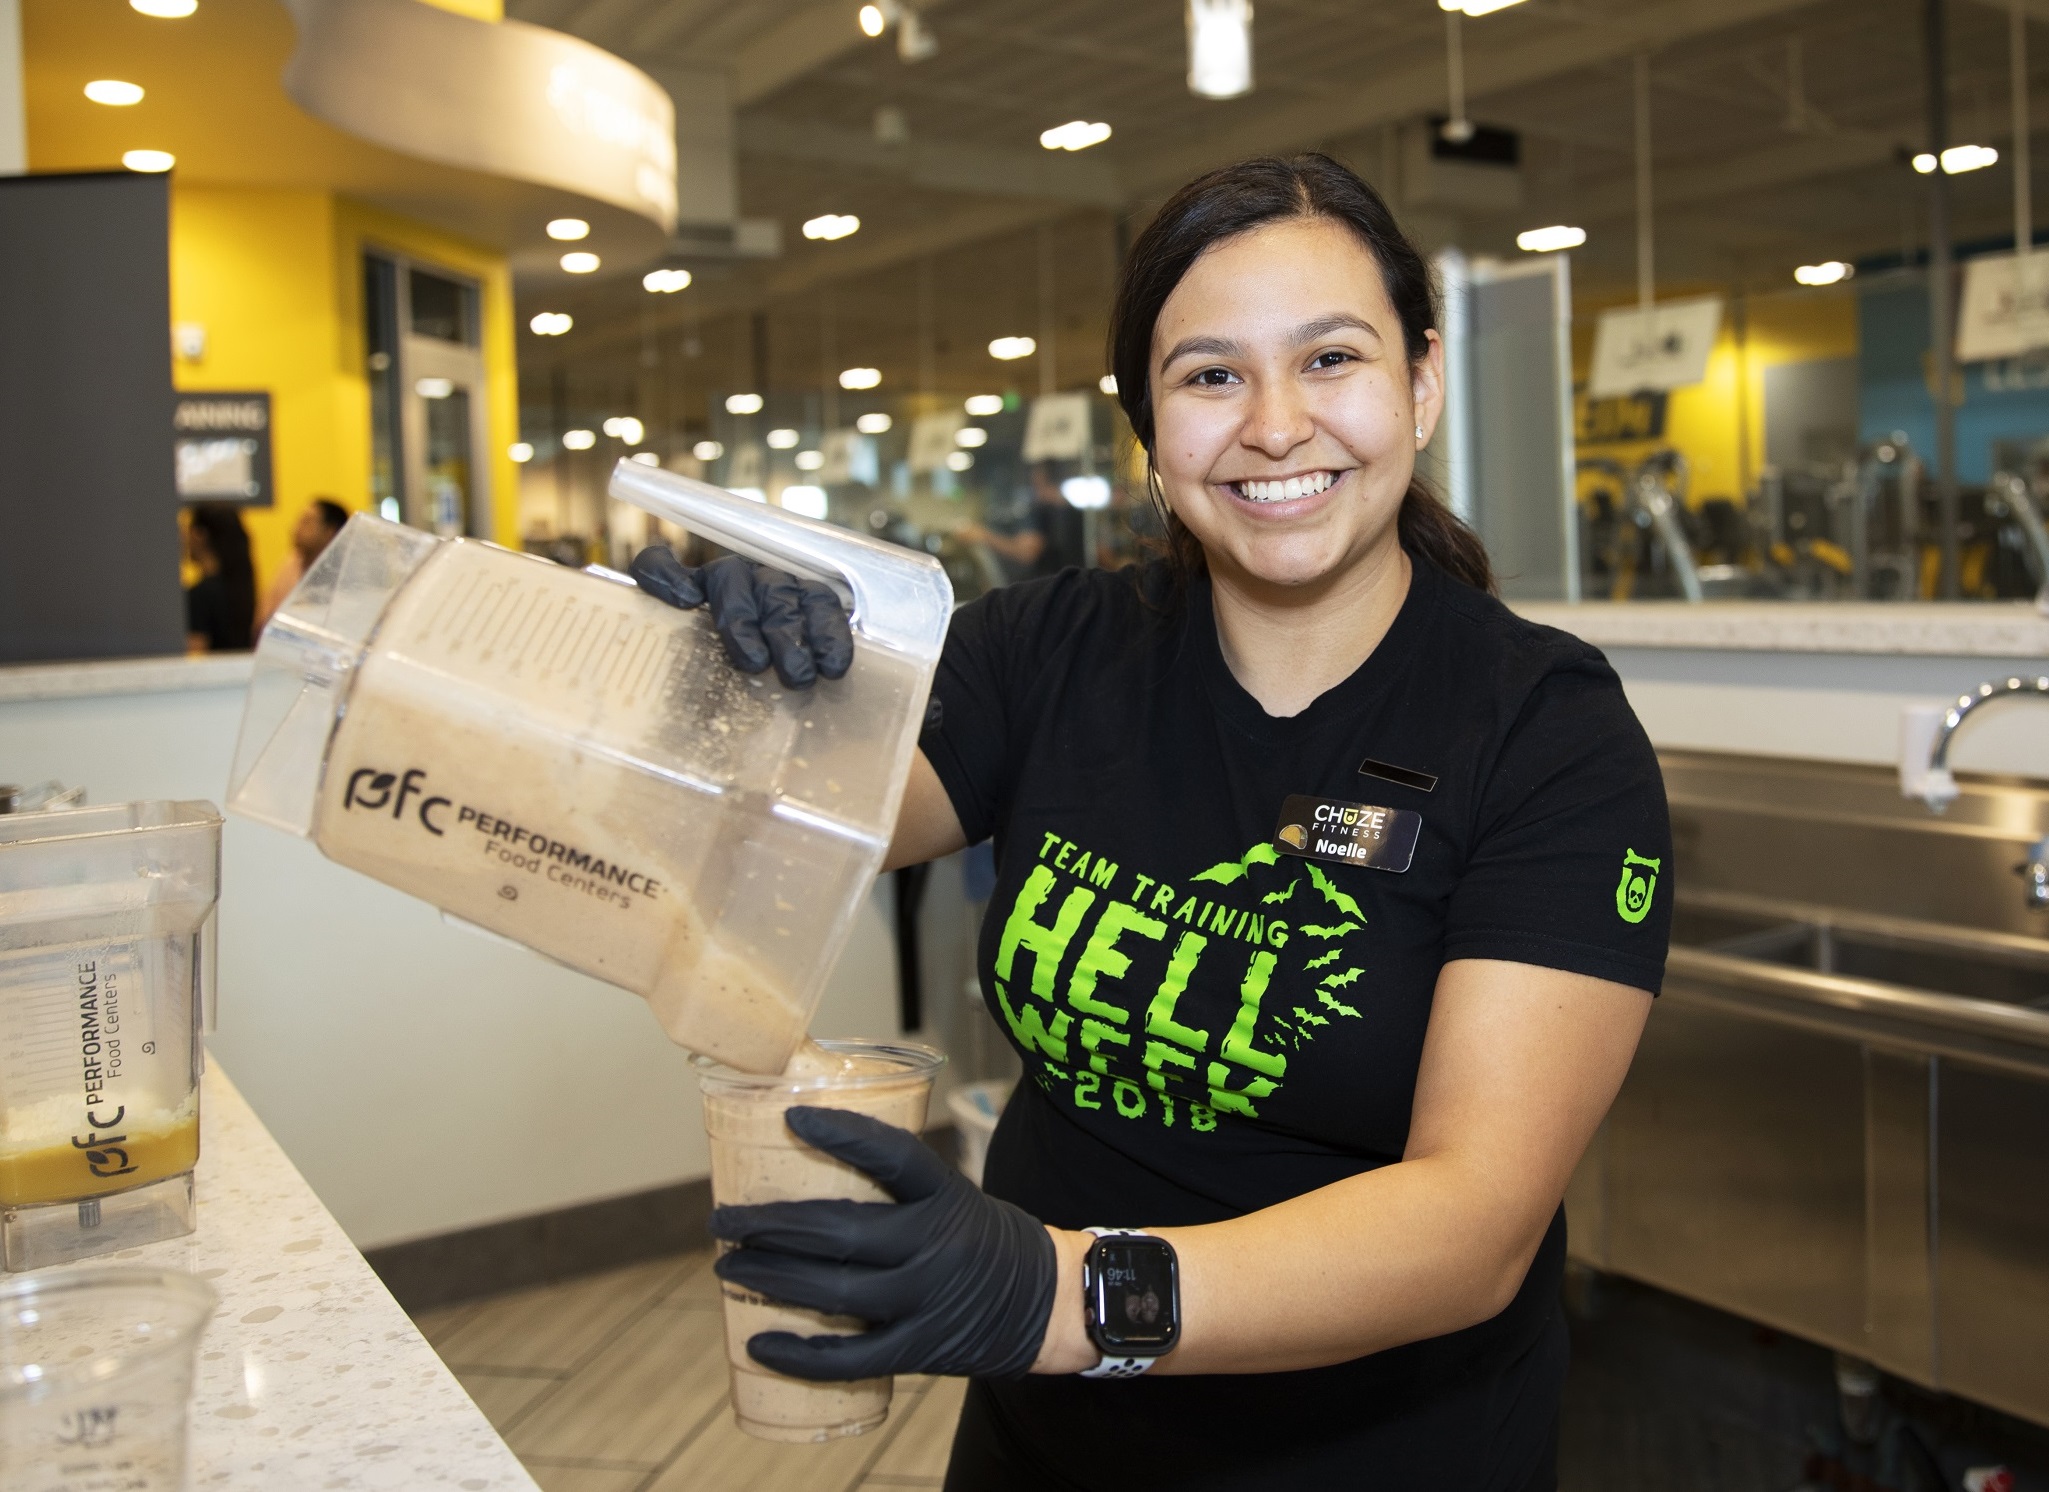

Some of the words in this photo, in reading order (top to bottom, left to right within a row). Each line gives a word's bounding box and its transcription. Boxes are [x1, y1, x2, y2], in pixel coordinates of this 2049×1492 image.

[1312, 822, 1382, 840] FITNESS
[1314, 804, 1386, 830] CHUZE
[457, 805, 662, 899] PERFORMANCE
[484, 840, 541, 874] Food
[546, 864, 632, 910] Centers
[1315, 838, 1367, 859] Noelle
[1038, 831, 1120, 890] TEAM
[1131, 872, 1290, 949] TRAINING
[994, 864, 1287, 1078] HELL
[78, 960, 104, 1106] PERFORMANCE
[103, 973, 120, 1035] Centers
[106, 1039, 122, 1079] Food
[1074, 1070, 1217, 1133] 2018
[1107, 1267, 1136, 1281] 11:46
